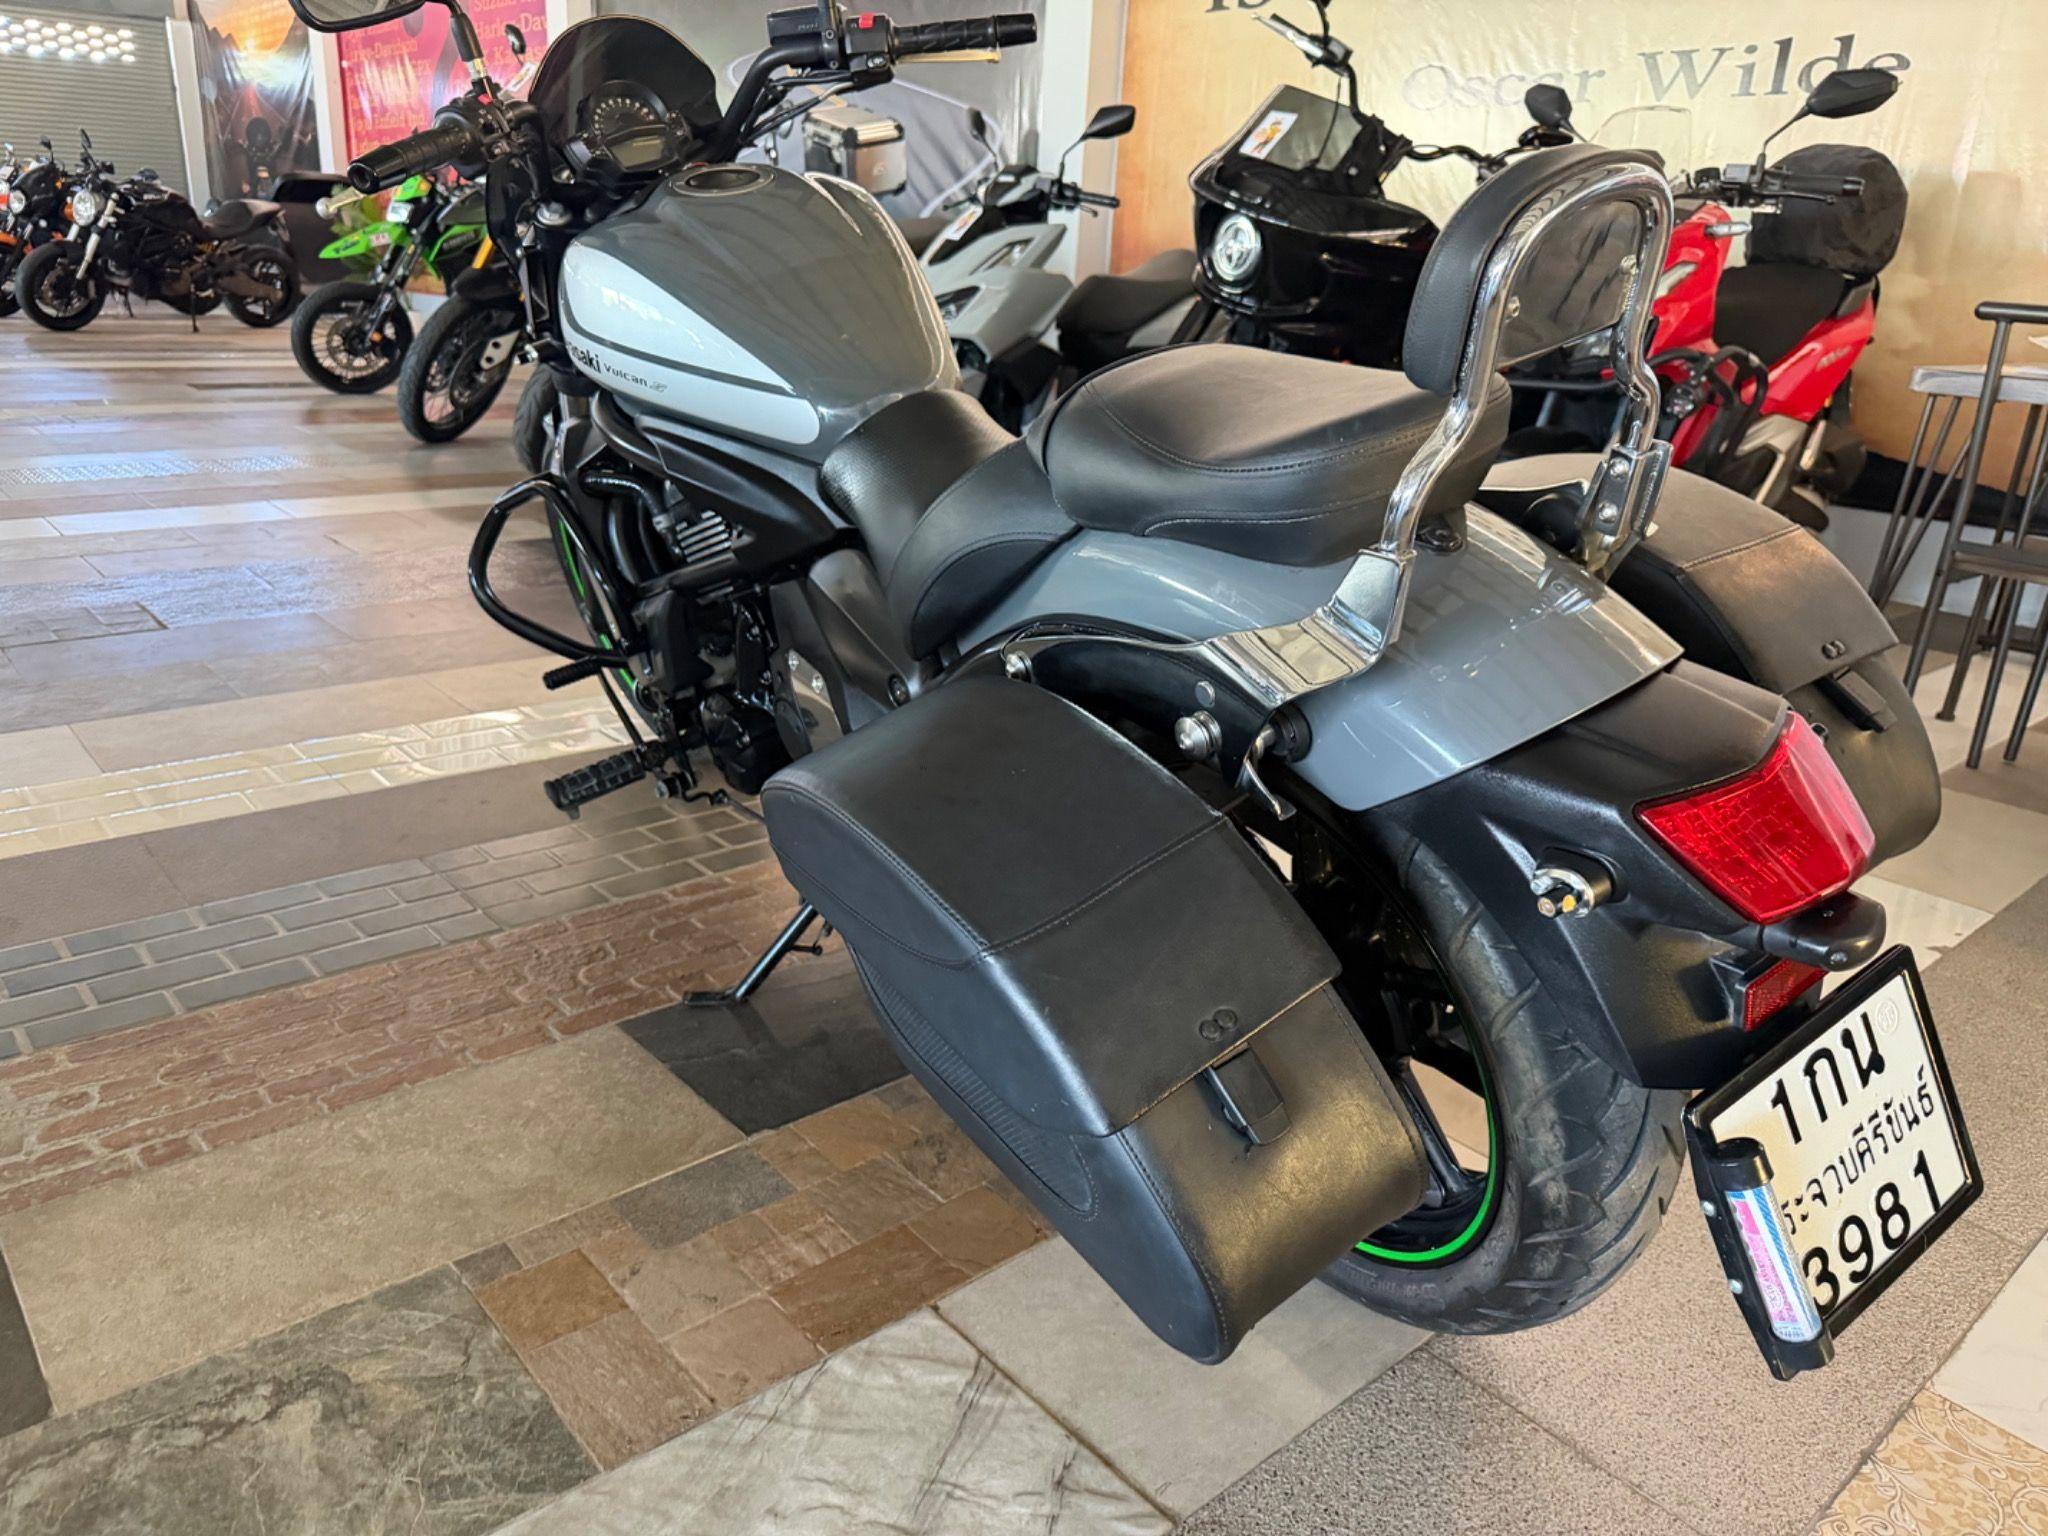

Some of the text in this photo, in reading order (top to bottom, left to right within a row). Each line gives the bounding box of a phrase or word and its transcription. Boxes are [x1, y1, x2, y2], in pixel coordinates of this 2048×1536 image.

[603, 362, 648, 387] Vulcan
[1771, 1012, 1885, 1145] 1กน
[1781, 1064, 1934, 1236] ระจวบคีรีขันธ์
[1802, 1150, 1941, 1317] 3981
